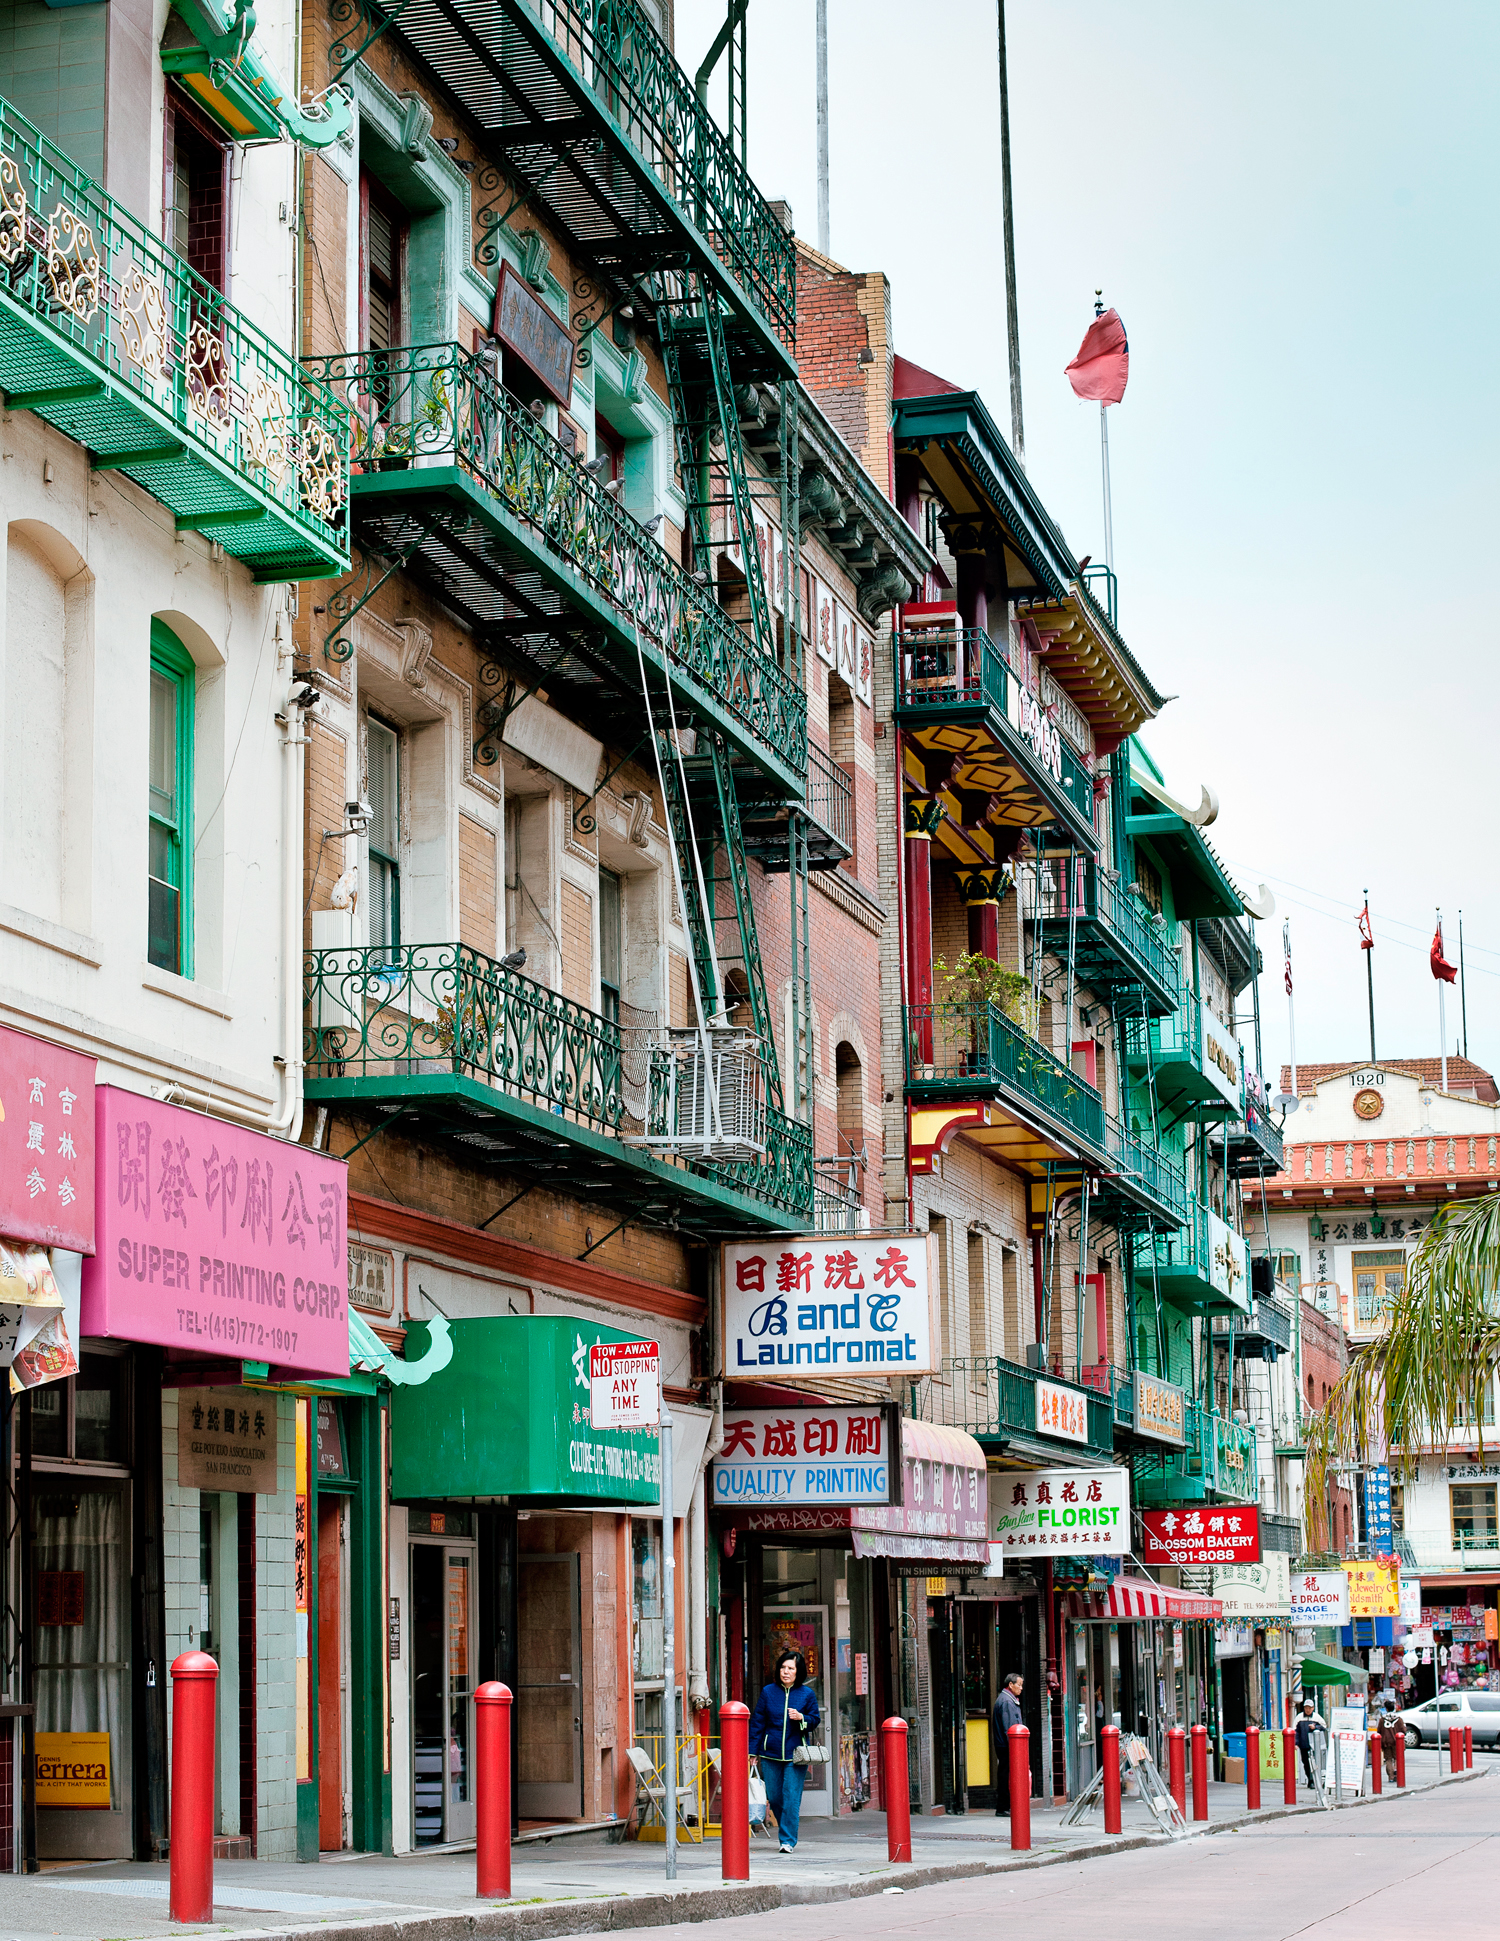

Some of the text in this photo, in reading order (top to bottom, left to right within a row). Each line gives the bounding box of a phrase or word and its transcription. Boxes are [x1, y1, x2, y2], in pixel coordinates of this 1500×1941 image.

[1350, 1073, 1384, 1086] 1920
[736, 1246, 916, 1294] 日新洗衣
[118, 1237, 190, 1290] SUPER
[200, 1255, 286, 1309] PRINTING
[293, 1276, 343, 1321] CORP.
[749, 1294, 900, 1336] B and C
[737, 1333, 916, 1367] Laundromat
[593, 1357, 656, 1376] NO STOPPING
[612, 1379, 637, 1393] ANY
[611, 1395, 640, 1410] TIME
[722, 1415, 881, 1458] 天成印刷
[229, 1447, 266, 1461] ASSOCIATION
[206, 1461, 252, 1477] SAN FRANCISCO
[716, 1466, 886, 1498] QUALITY PRINTING
[1011, 1480, 1102, 1506] 真真花店
[1038, 1507, 1119, 1527] FLORIST
[1160, 1511, 1242, 1536] 幸福餅家
[1150, 1536, 1254, 1550] BLOSSOM BAKERY
[1169, 1550, 1235, 1562] 391-8088
[899, 1567, 911, 1575] TIN
[913, 1567, 939, 1575] SHING
[942, 1566, 978, 1575] PRINTING
[1354, 1583, 1385, 1594] Jewelry
[1300, 1594, 1339, 1604] DRAGON
[1291, 1613, 1338, 1622] 15-781-7777
